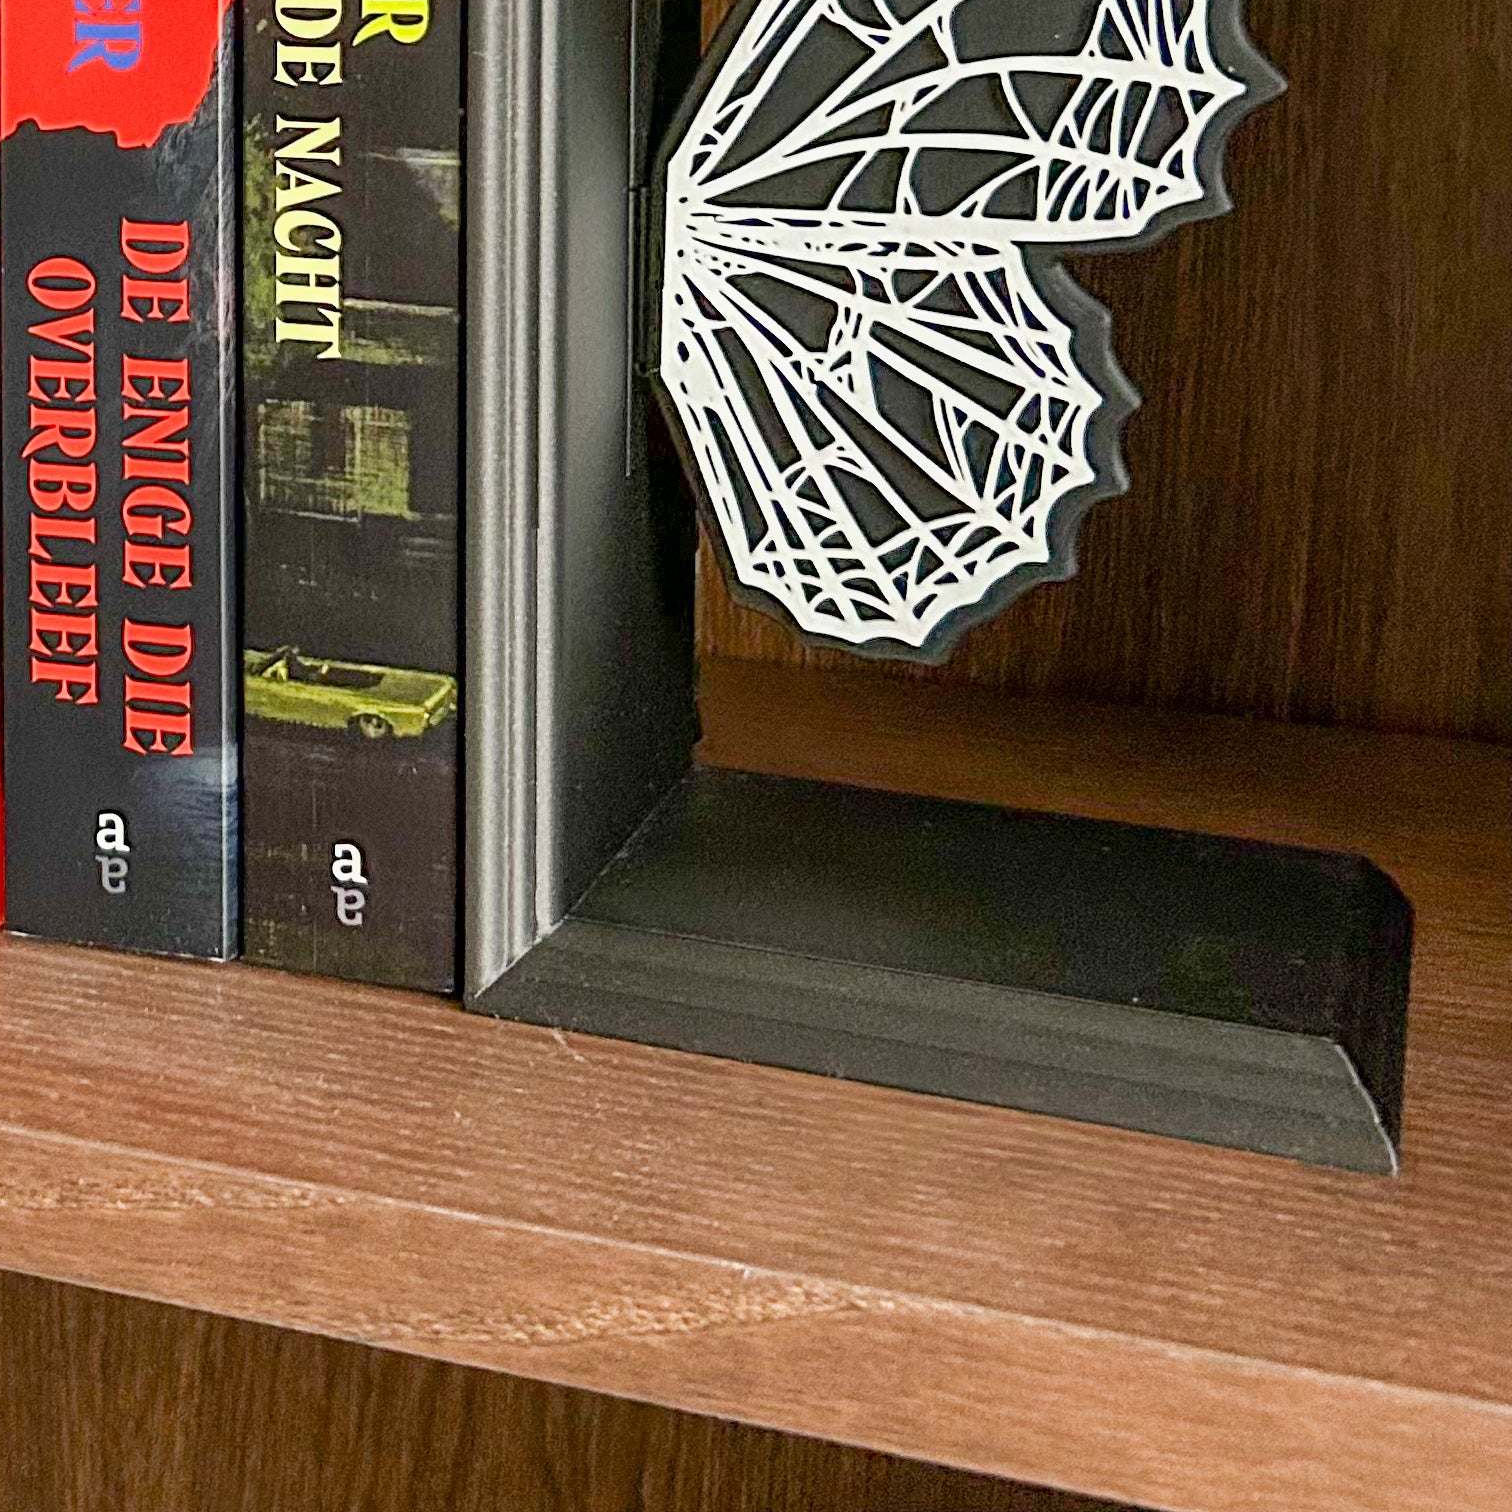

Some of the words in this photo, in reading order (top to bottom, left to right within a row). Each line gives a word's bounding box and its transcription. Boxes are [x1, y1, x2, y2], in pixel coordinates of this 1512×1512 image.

[120, 217, 191, 324] DE
[273, 114, 343, 360] NACHT
[20, 256, 99, 705] OVERBLEEF
[120, 354, 193, 590] ENIGE
[121, 617, 194, 757] DIE
